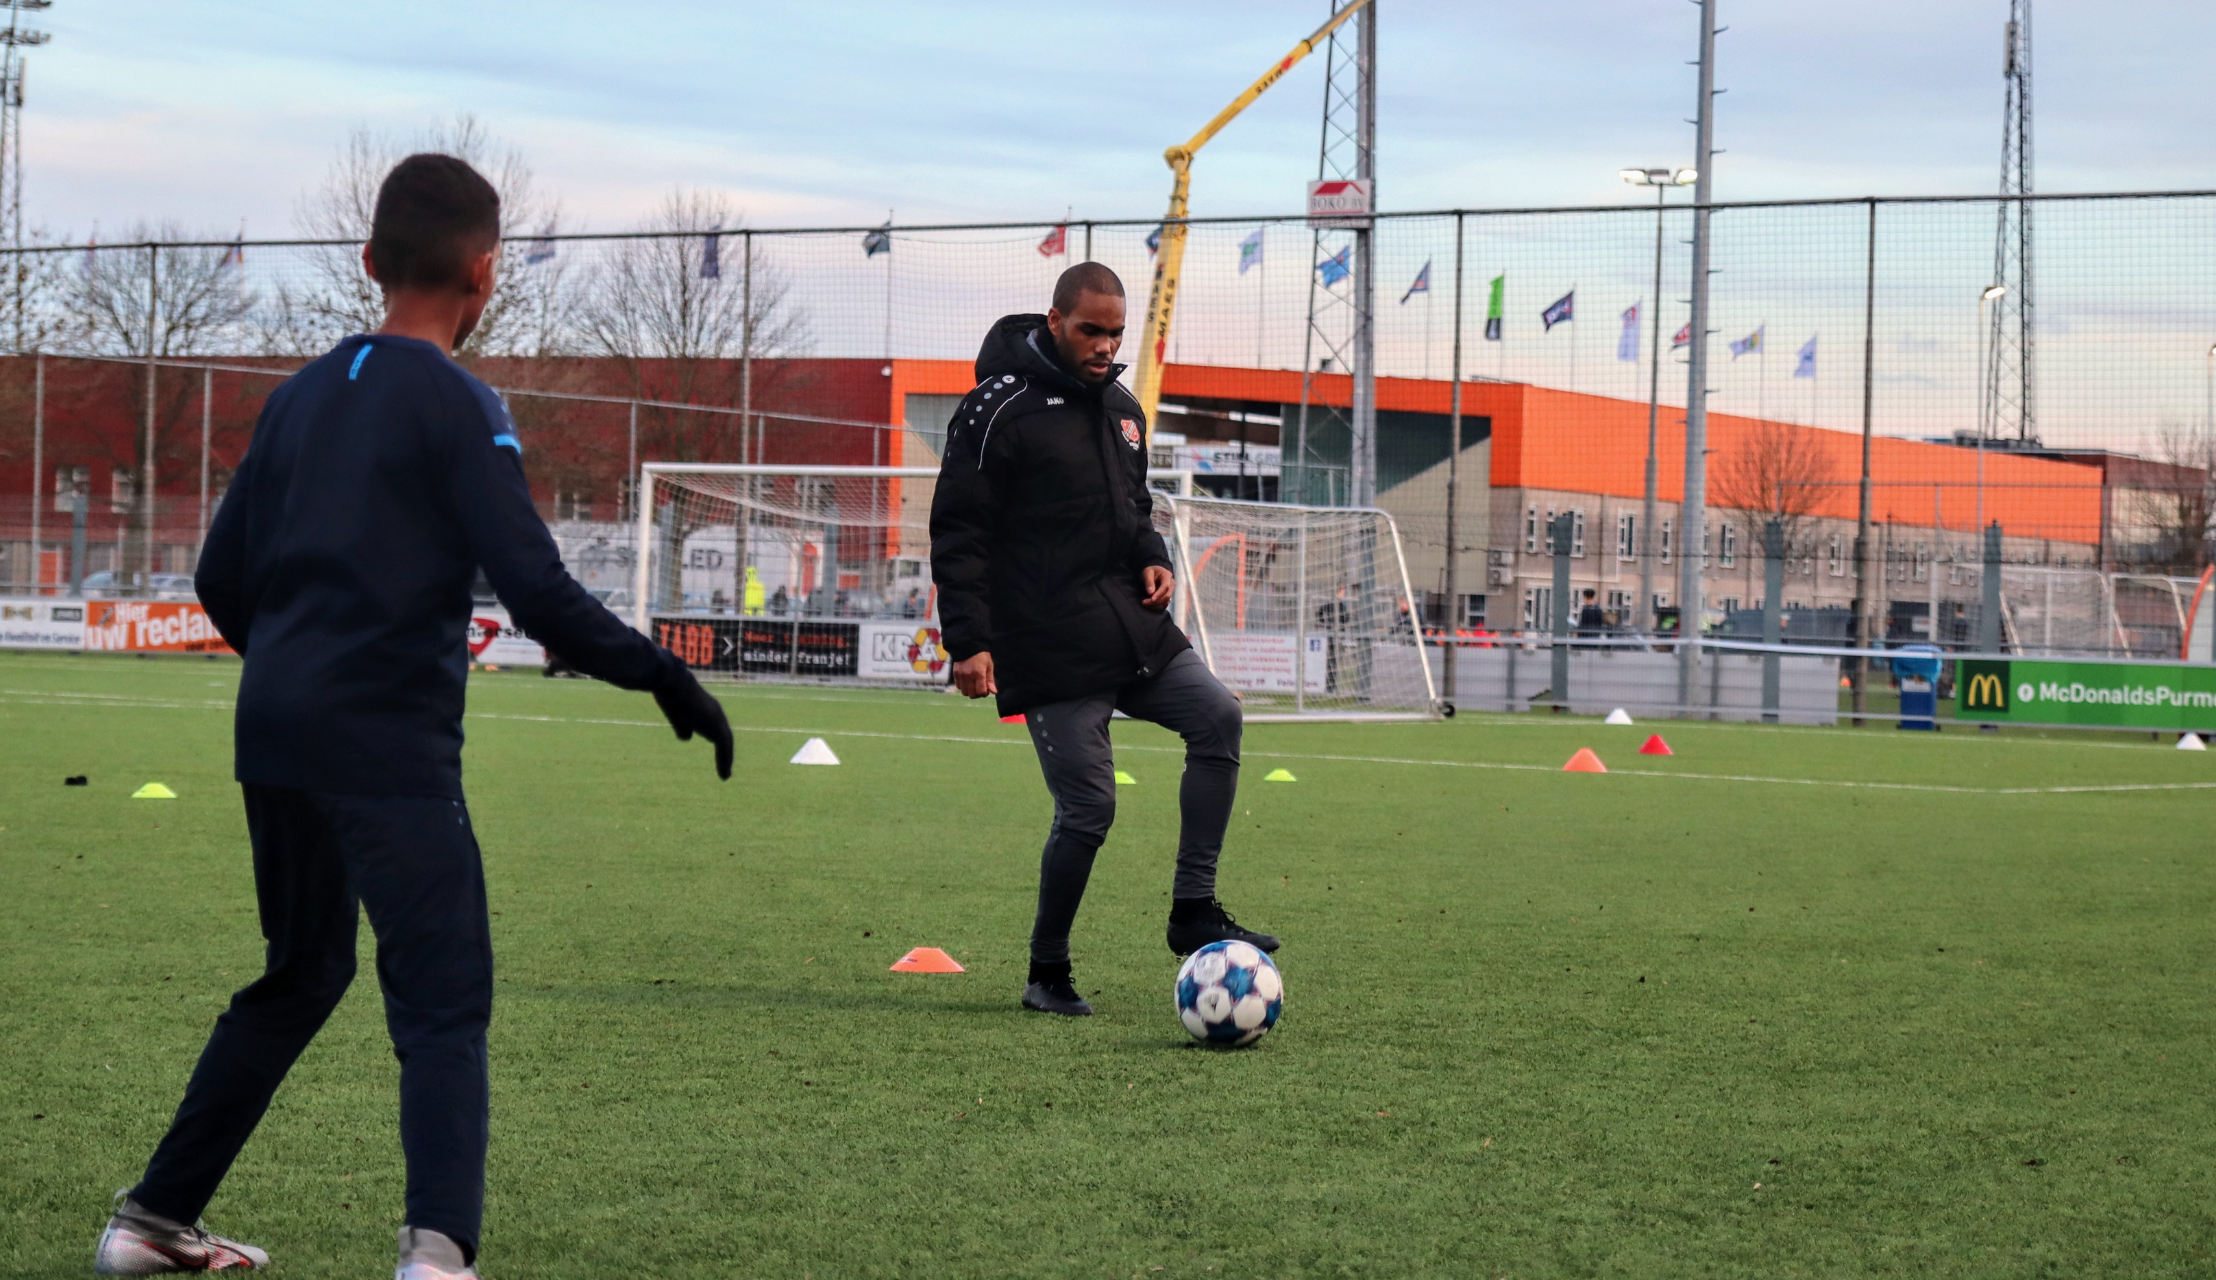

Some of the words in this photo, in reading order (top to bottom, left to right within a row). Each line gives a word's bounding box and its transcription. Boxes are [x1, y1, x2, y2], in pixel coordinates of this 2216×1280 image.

[1046, 397, 1065, 406] JAKO
[113, 603, 149, 623] Hier
[659, 624, 714, 666] TABB
[743, 648, 789, 663] minder
